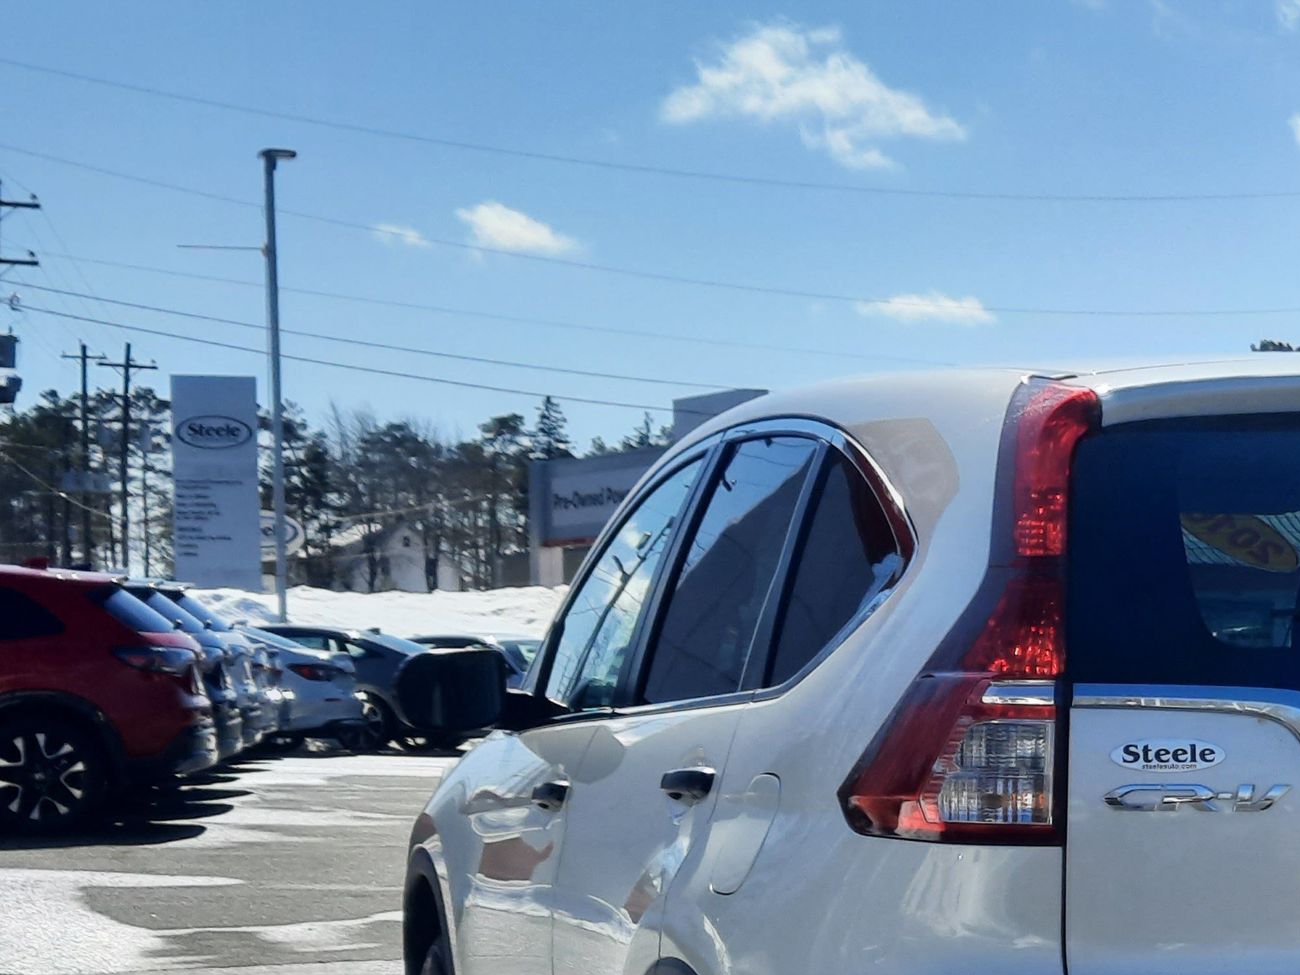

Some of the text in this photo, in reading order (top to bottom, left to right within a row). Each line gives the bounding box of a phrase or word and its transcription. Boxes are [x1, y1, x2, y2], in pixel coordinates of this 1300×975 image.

[187, 423, 241, 437] Steele
[1121, 743, 1216, 763] Steele
[1103, 783, 1293, 812] CR-V
